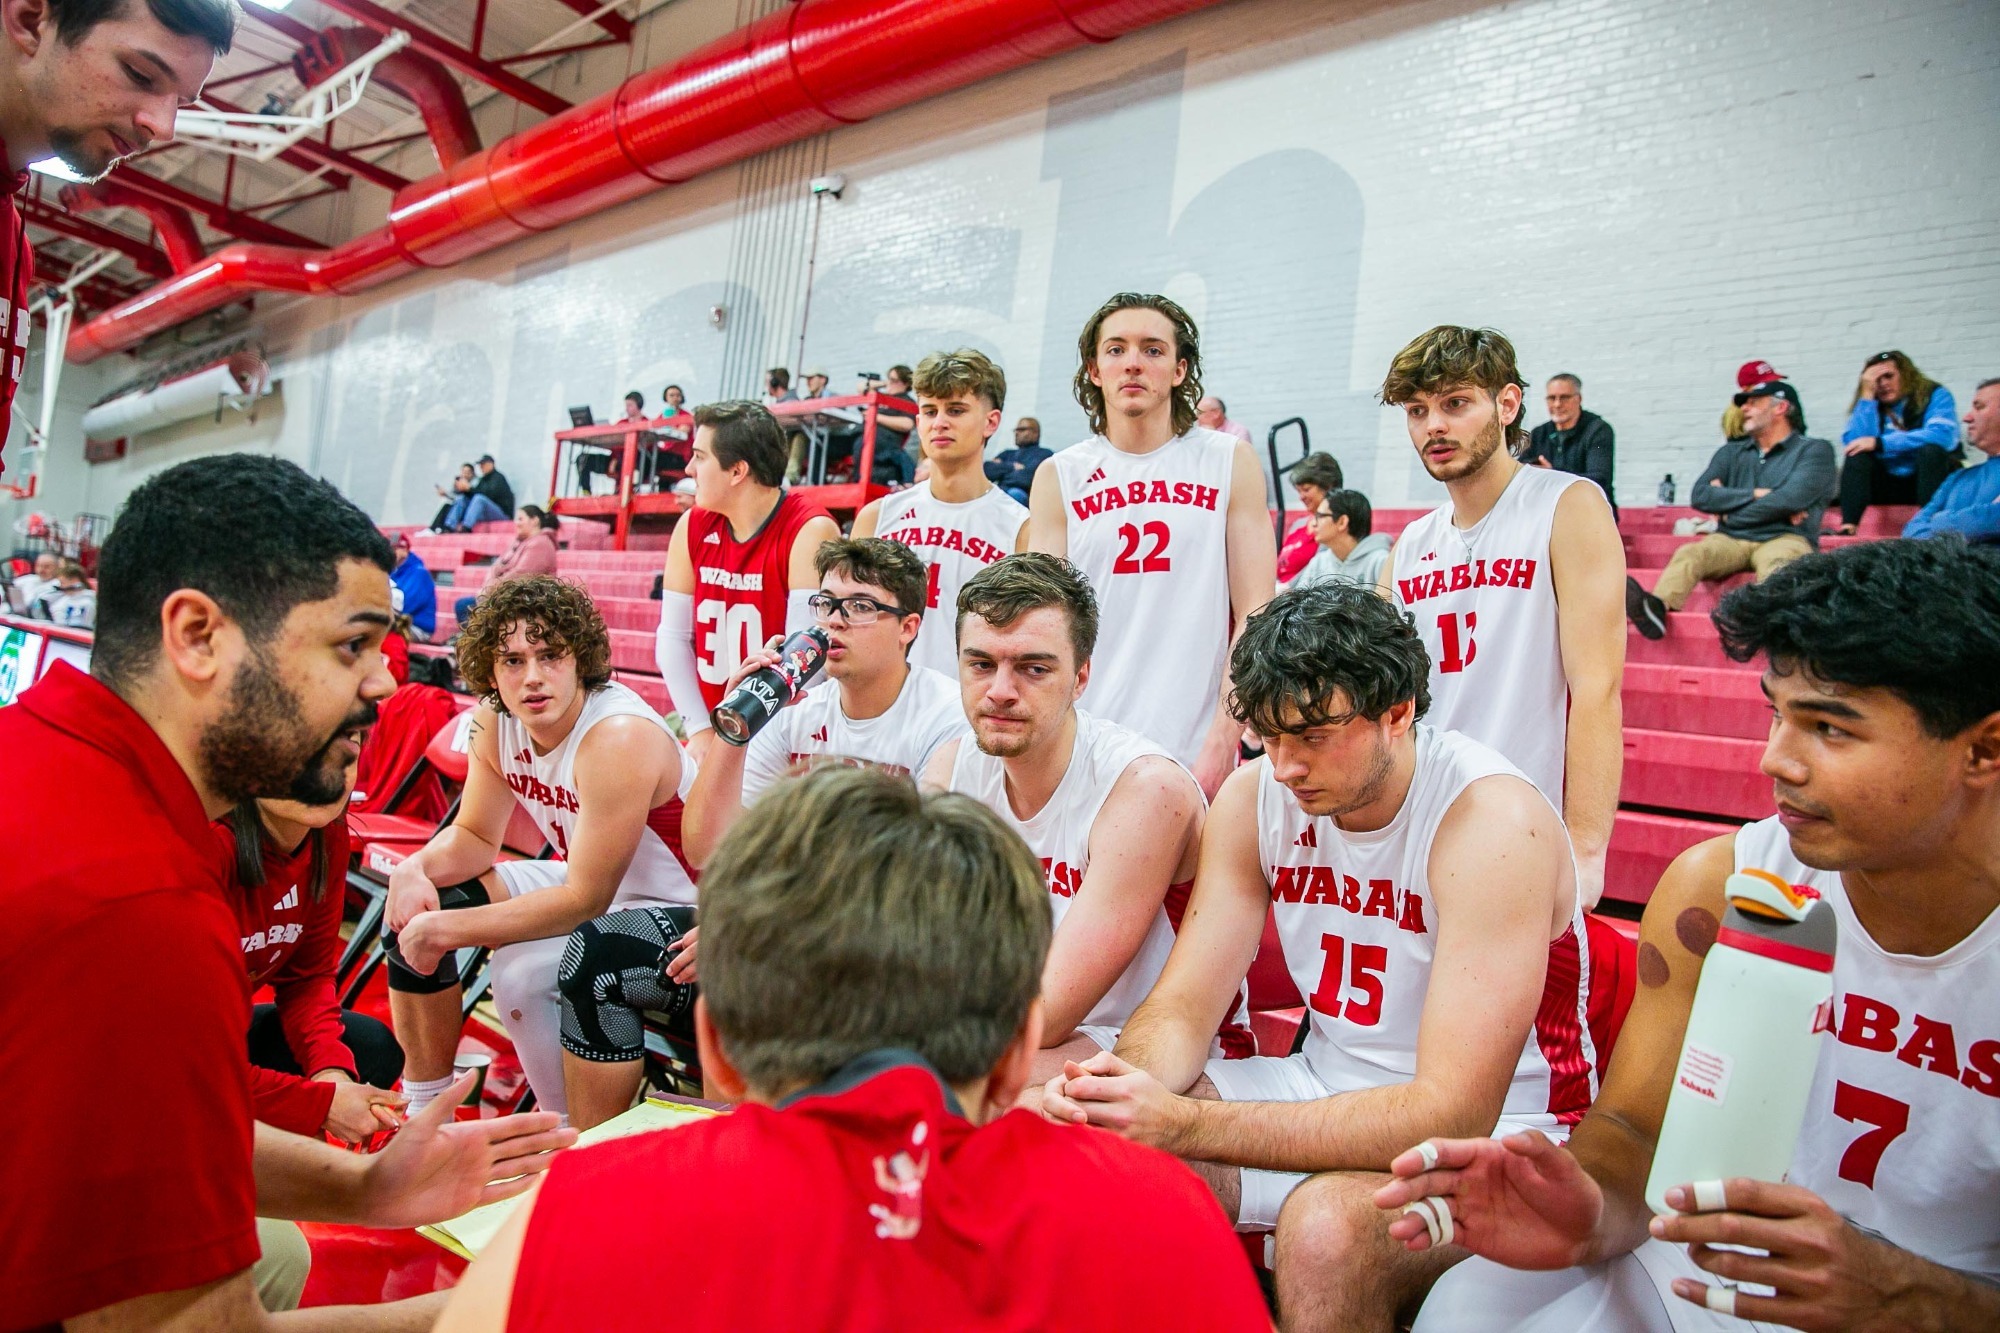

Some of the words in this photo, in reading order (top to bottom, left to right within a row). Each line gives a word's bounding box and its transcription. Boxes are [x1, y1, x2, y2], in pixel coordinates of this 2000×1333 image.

[1072, 480, 1219, 521] WABASH
[1113, 521, 1171, 574] 22
[1398, 559, 1537, 605] WABASH
[697, 599, 763, 685] 30
[1309, 933, 1388, 1026] 15
[1833, 1079, 1910, 1191] 7
